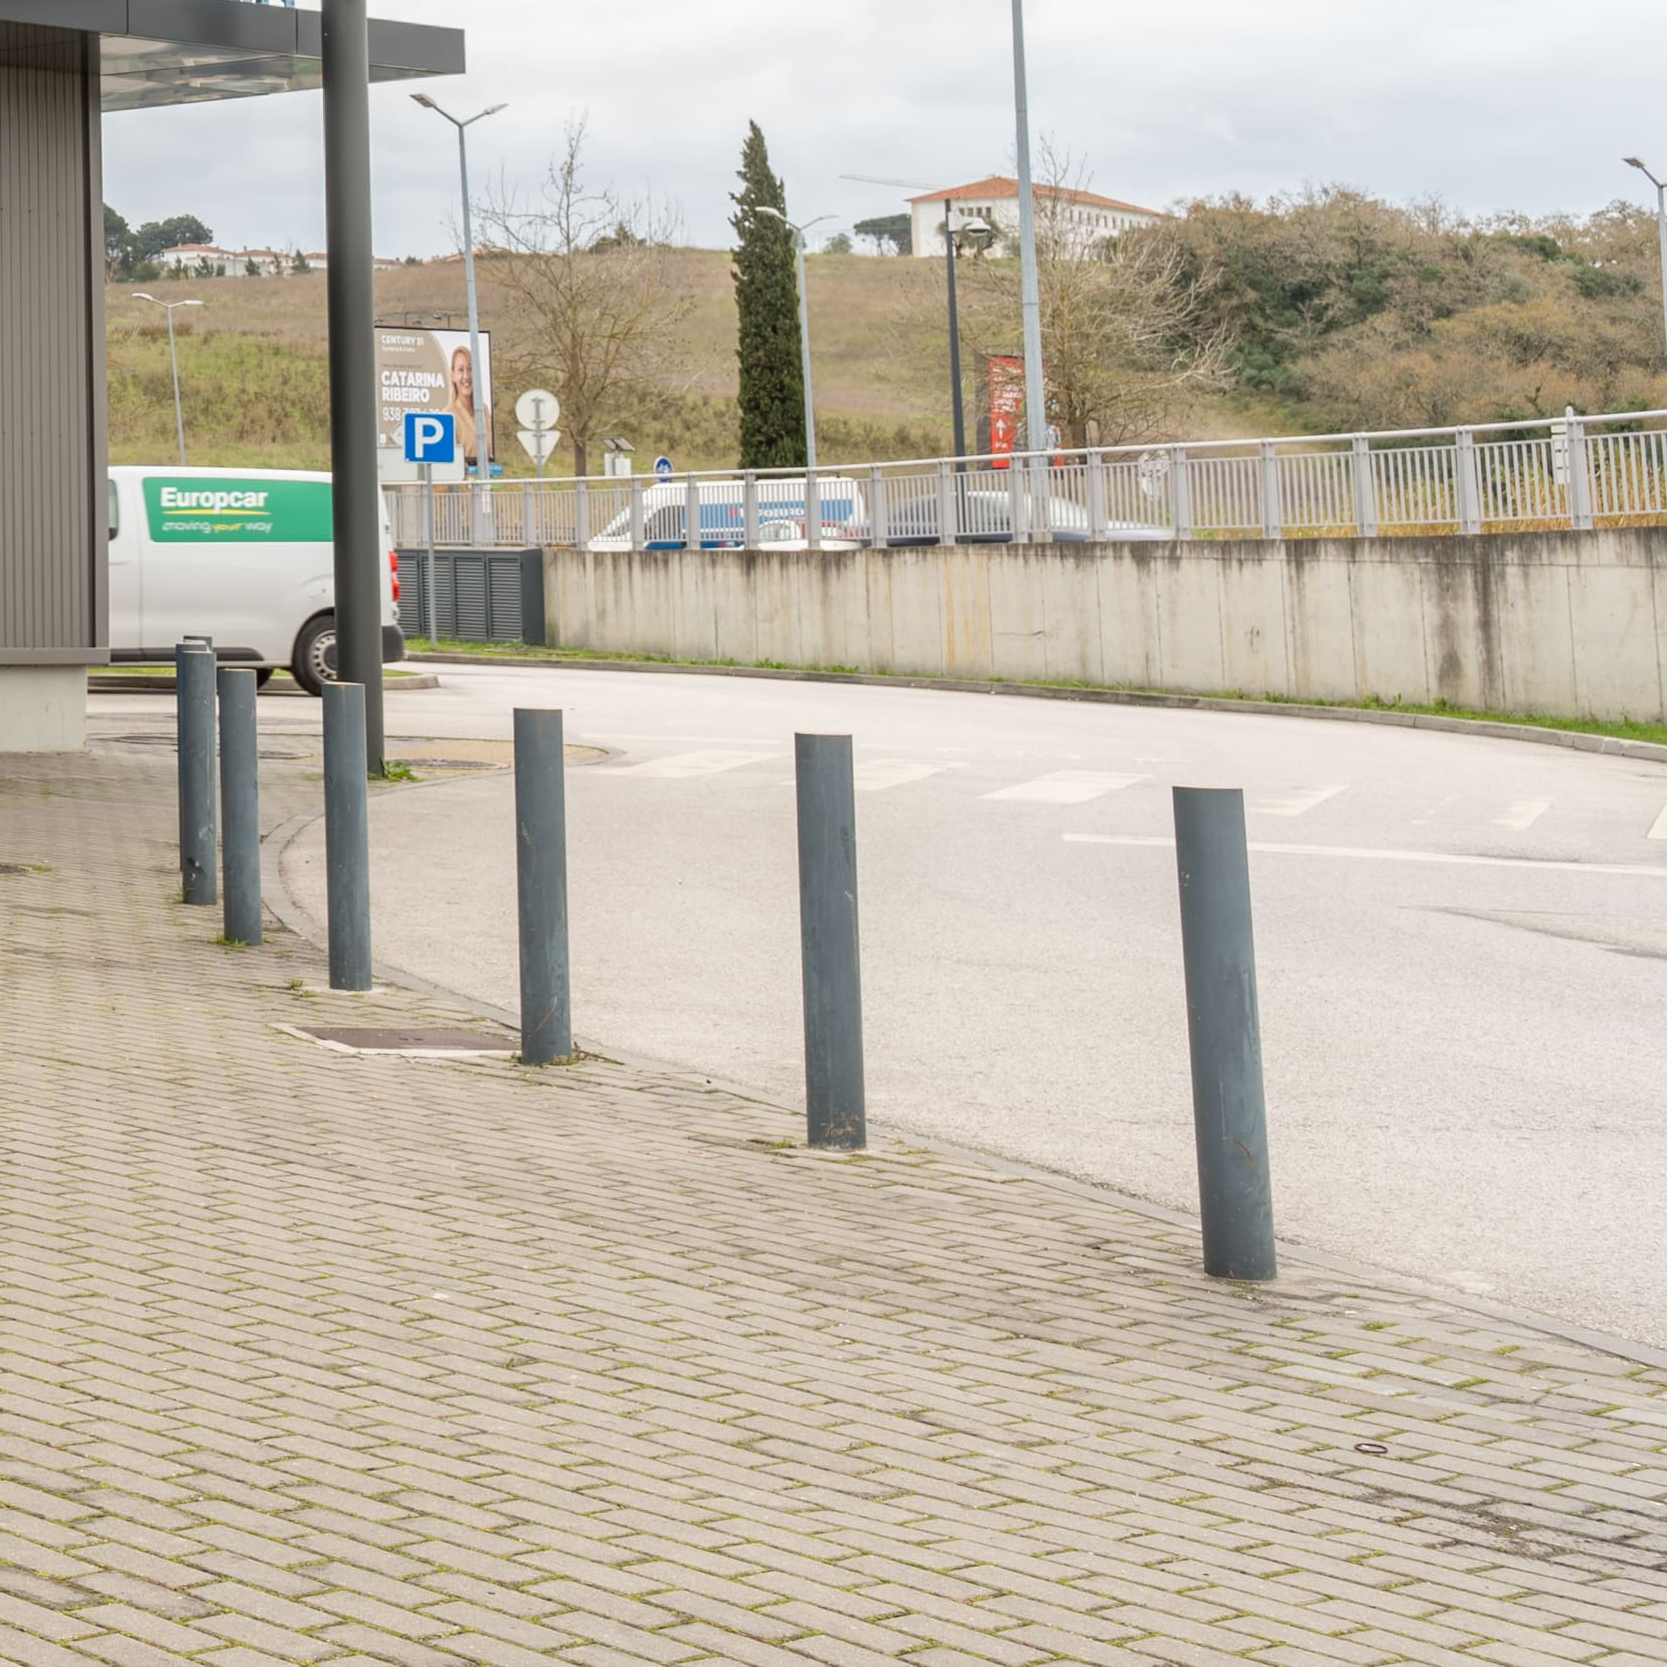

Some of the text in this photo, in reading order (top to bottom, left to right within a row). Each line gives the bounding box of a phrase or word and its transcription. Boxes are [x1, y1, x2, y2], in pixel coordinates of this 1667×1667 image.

[381, 371, 445, 388] CATARINA
[381, 387, 430, 403] RIBEIRO
[382, 407, 402, 421] 938
[414, 417, 444, 458] P
[160, 486, 269, 514] Europcar
[162, 520, 273, 533] moving your way
